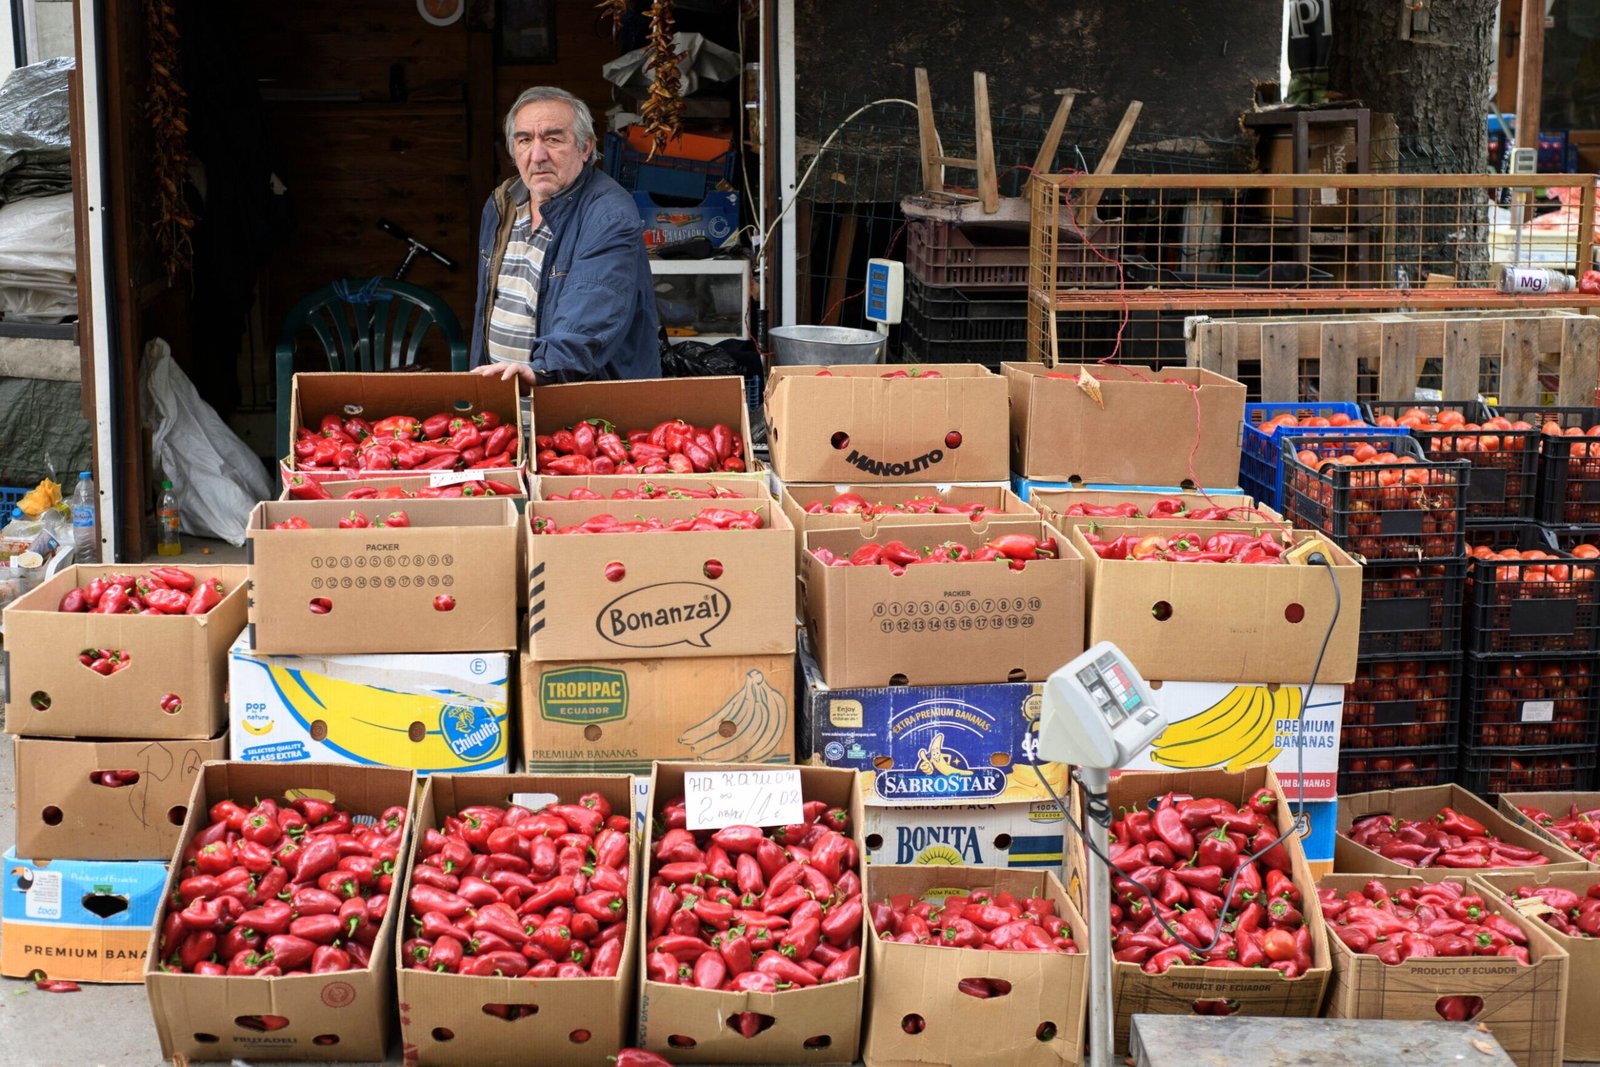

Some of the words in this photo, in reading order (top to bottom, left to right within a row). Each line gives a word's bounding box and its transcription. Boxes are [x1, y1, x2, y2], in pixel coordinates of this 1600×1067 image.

[1520, 276, 1542, 292] Mg
[845, 449, 943, 477] MANOLITO
[366, 543, 399, 551] PACKER
[610, 594, 720, 637] Bonanza!
[547, 681, 621, 698] TROPIPAC
[246, 703, 266, 712] pop
[560, 706, 609, 715] ECUADOR
[892, 715, 916, 734] EXTRA
[916, 707, 954, 721] PREMIUM
[955, 709, 991, 731] BANANAS
[1276, 720, 1335, 732] PREMIUM
[451, 721, 500, 755] Chiquita
[1274, 735, 1335, 748] BANANAS
[247, 747, 276, 755] SELECTED
[276, 744, 301, 752] QUALITY
[250, 753, 275, 761] CLASS
[276, 750, 303, 760] EXTRA
[532, 750, 583, 759] PREMIUM
[587, 749, 638, 758] BANANAS
[895, 826, 984, 865] BONITA
[24, 945, 98, 958] PREMIUM
[1410, 967, 1457, 975] PRODUCT
[1458, 967, 1471, 975] OF
[1472, 966, 1518, 975] ECUADOR
[1172, 981, 1212, 991] PRODUCT
[1229, 984, 1271, 992] ECUADOR
